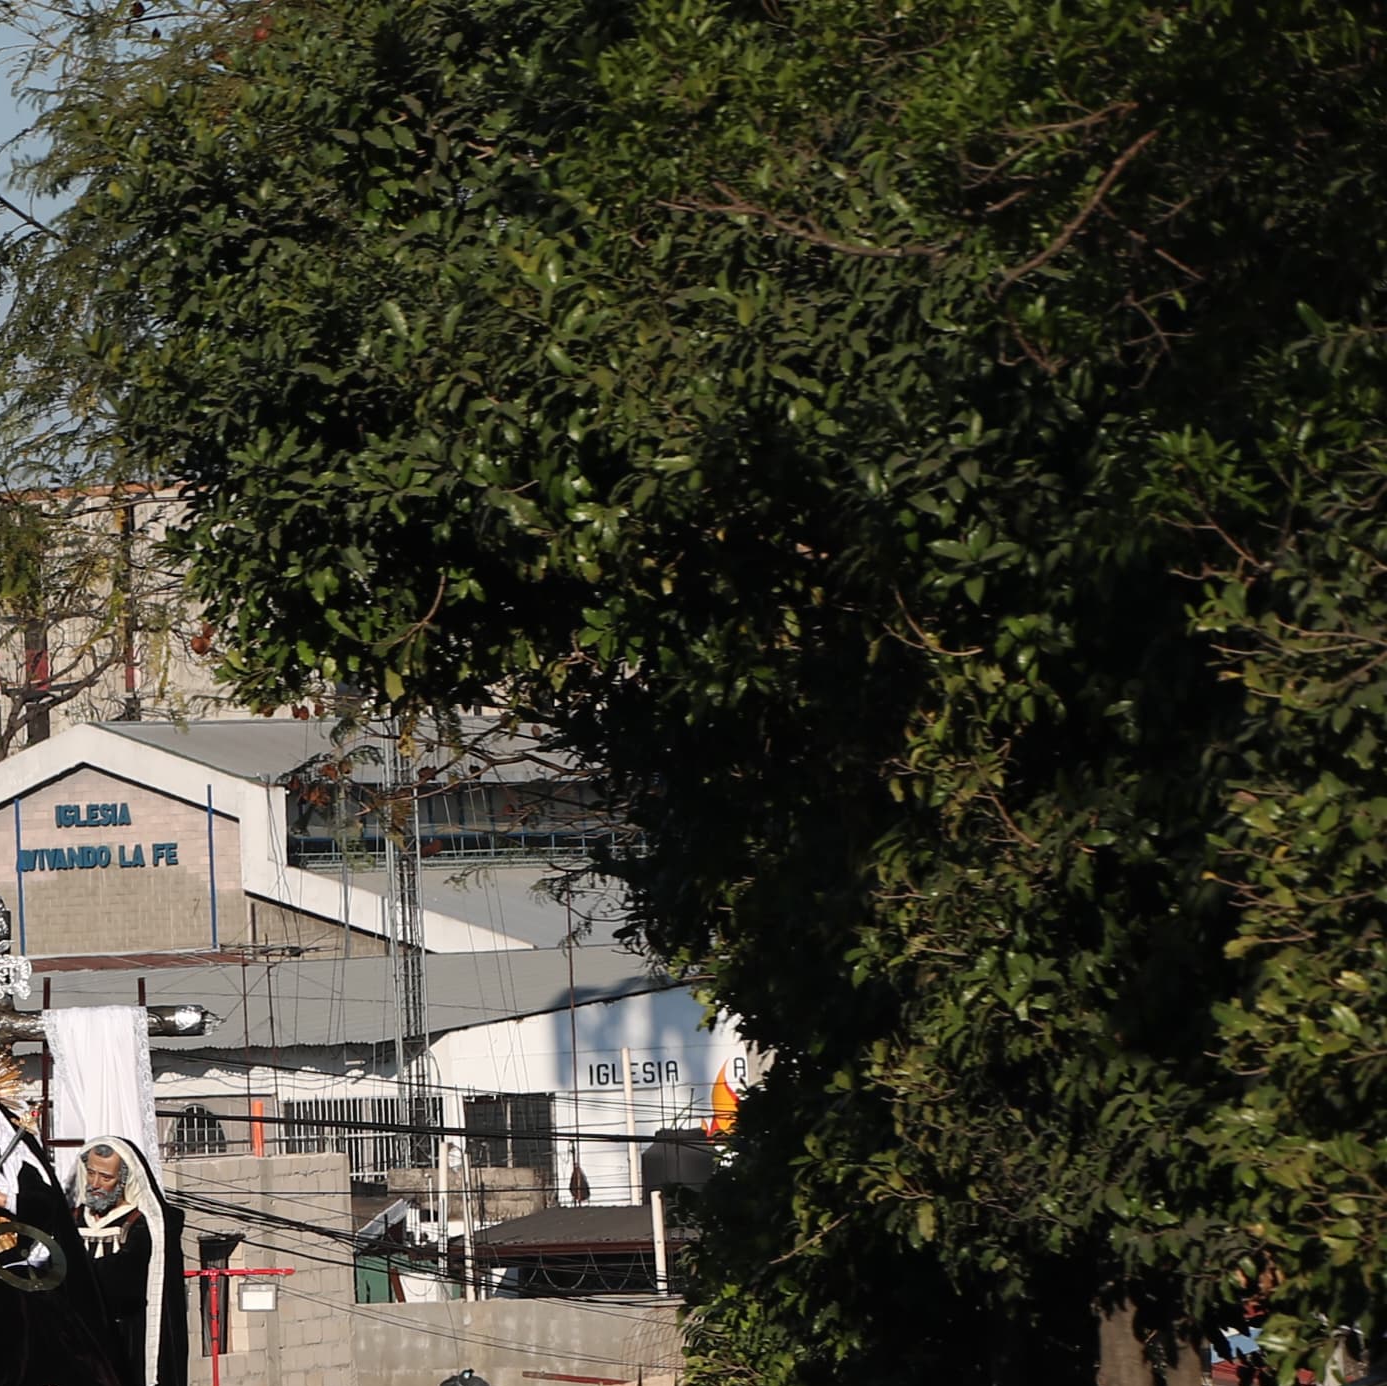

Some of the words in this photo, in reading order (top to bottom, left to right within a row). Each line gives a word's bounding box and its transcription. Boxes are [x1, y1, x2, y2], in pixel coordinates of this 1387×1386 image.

[55, 802, 132, 828] IGLESIA
[118, 844, 146, 868] LA
[152, 842, 179, 867] FE
[589, 1060, 679, 1086] IGLESIA
